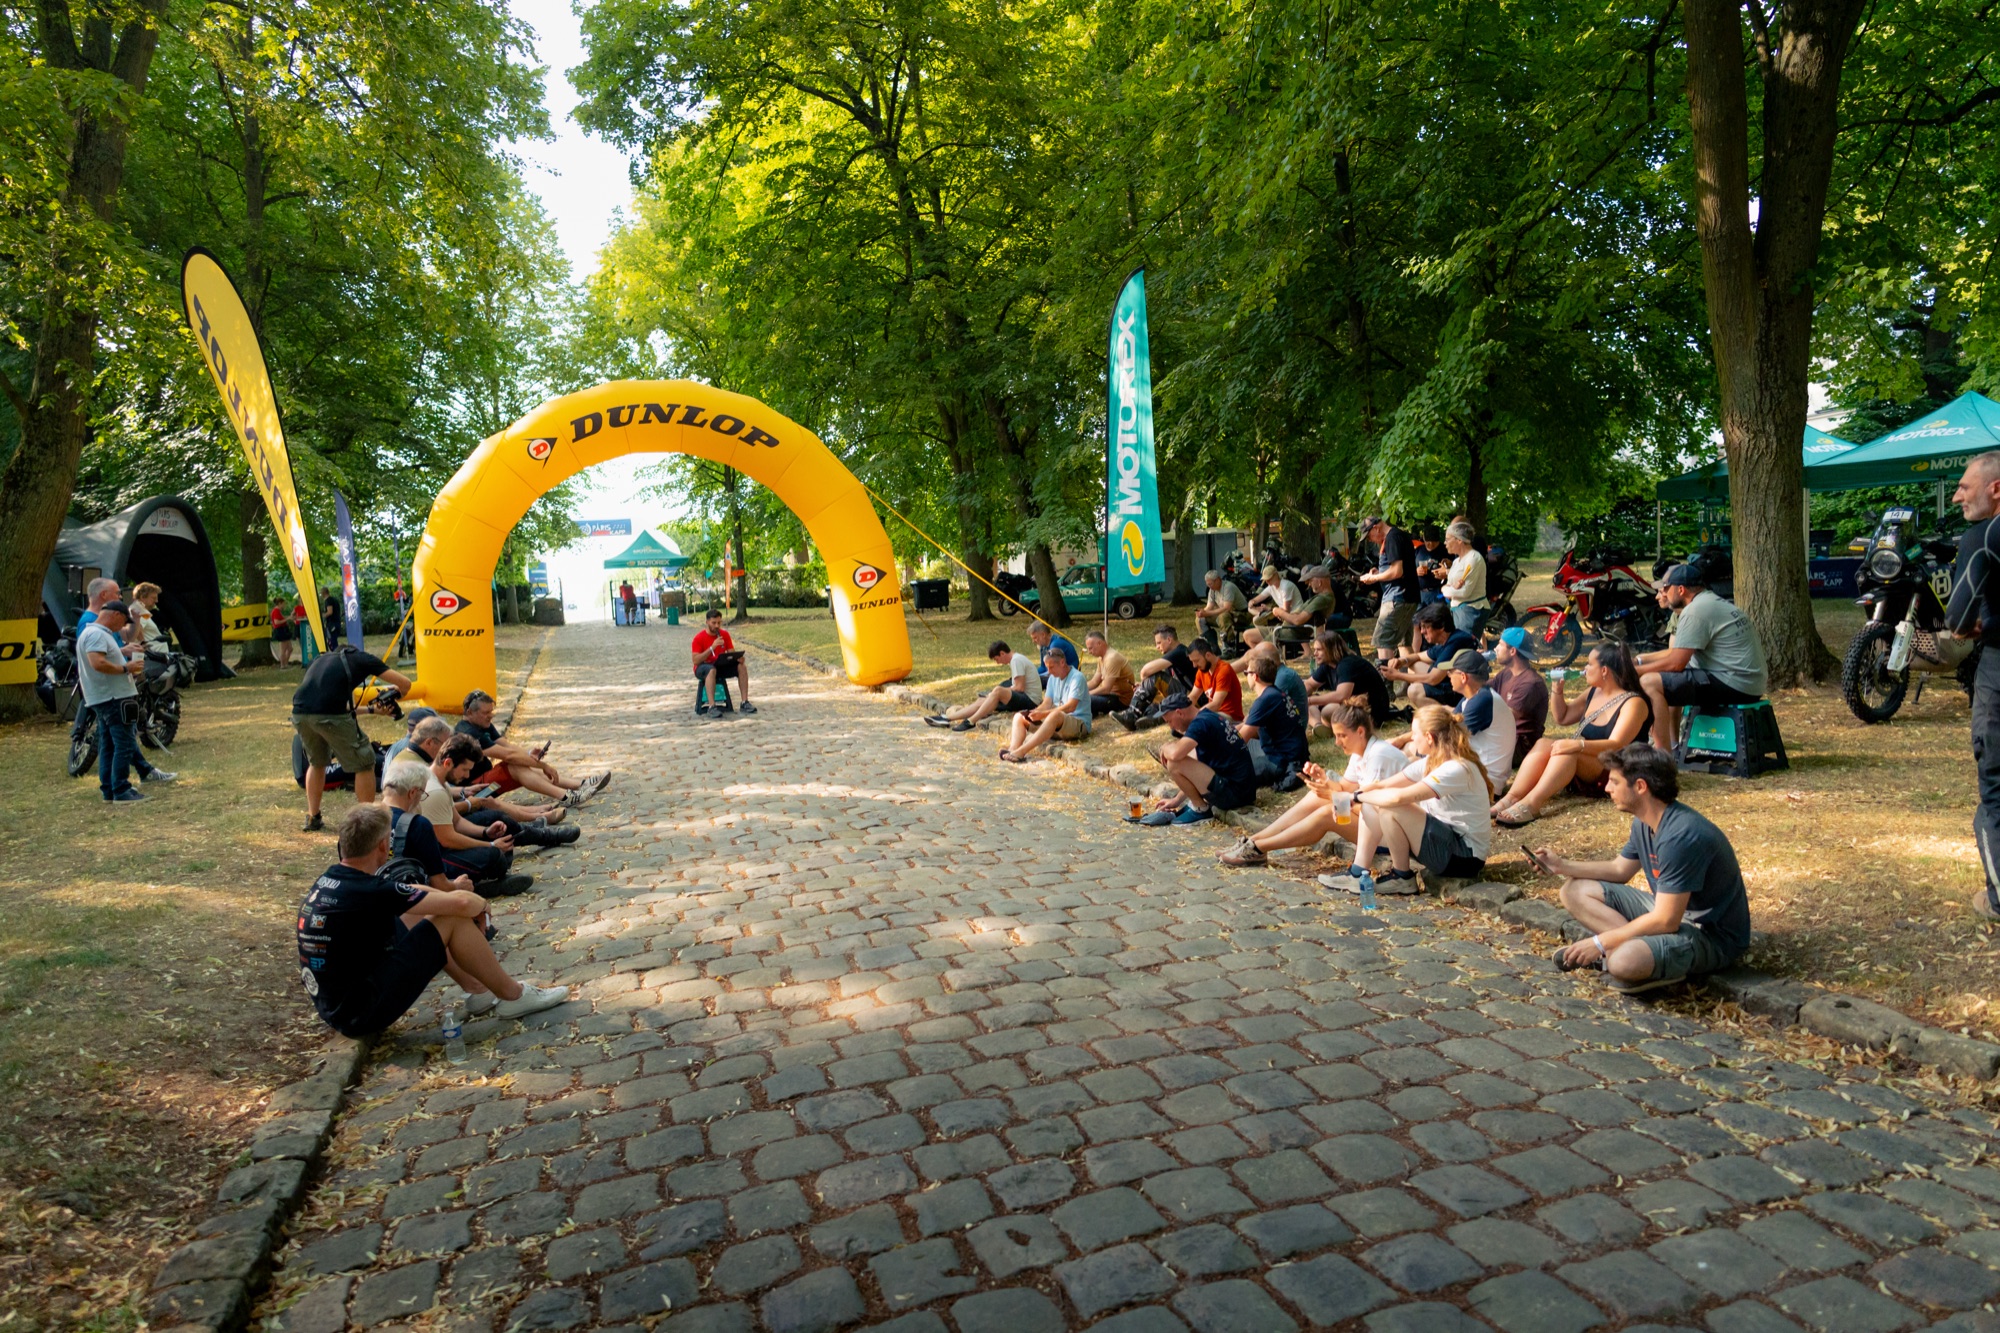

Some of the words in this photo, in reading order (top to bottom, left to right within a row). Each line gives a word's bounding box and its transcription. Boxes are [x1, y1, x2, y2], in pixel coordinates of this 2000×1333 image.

[1117, 311, 1143, 515] MOTOREX
[570, 403, 780, 448] DUNLOP
[1884, 427, 1971, 443] MOTOREX
[850, 597, 899, 612] DUNLOP
[424, 629, 485, 637] DUNLOP
